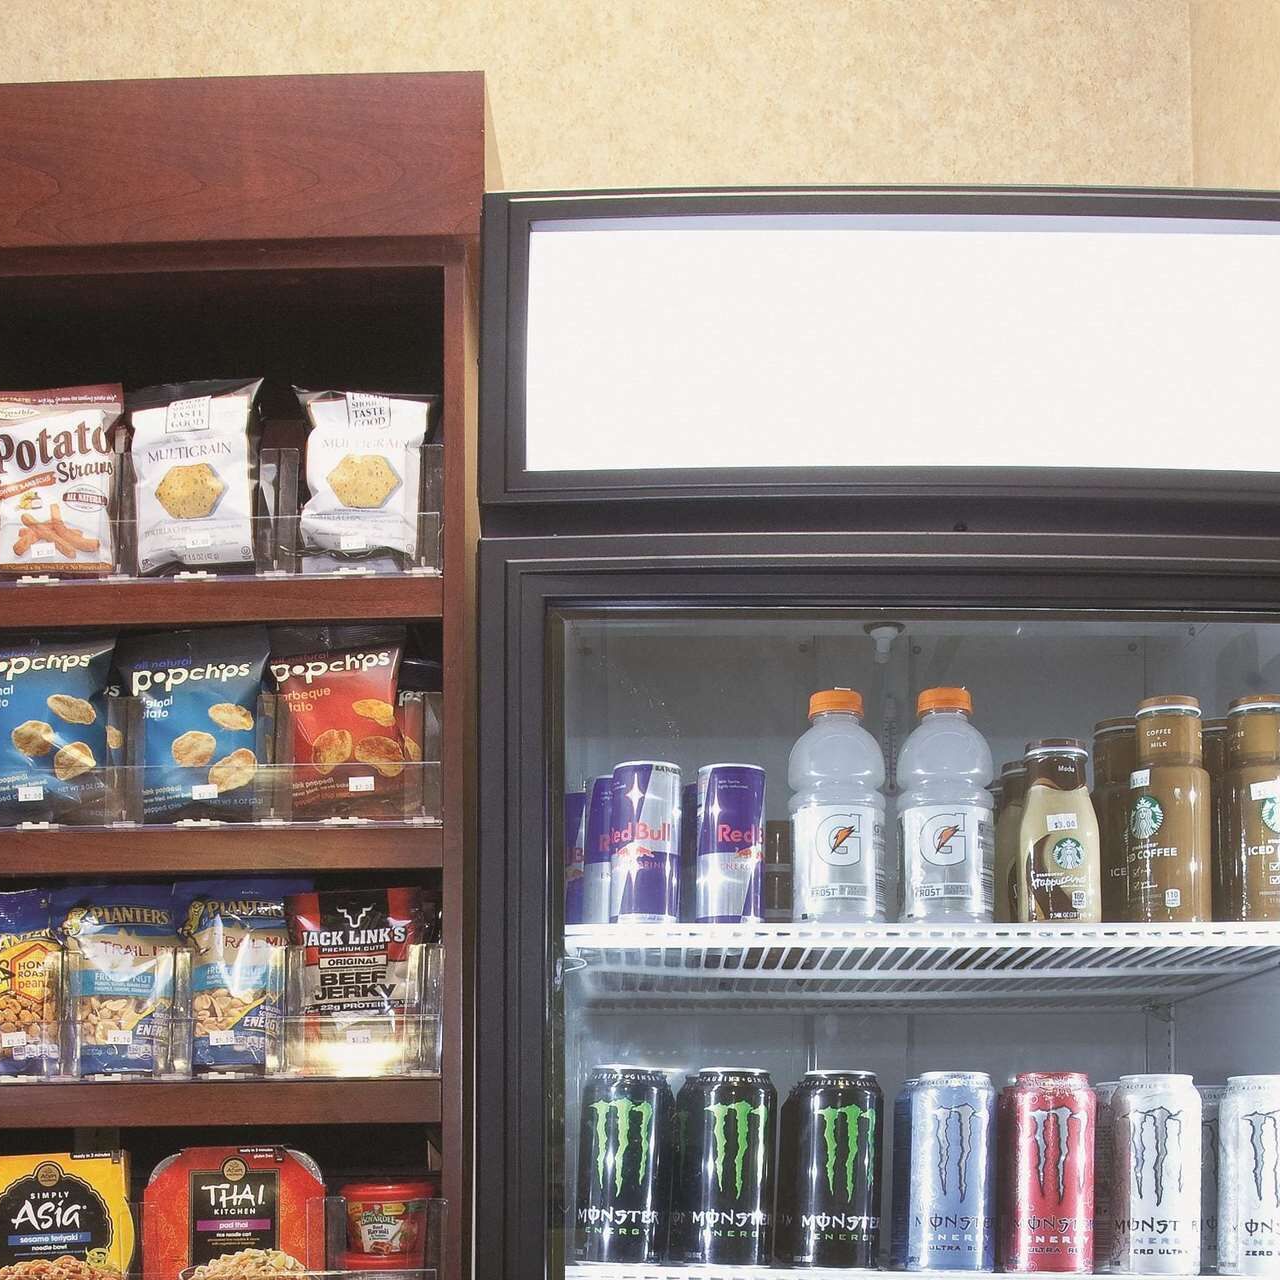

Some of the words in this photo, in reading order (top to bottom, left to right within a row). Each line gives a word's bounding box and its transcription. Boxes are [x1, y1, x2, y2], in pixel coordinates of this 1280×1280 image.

[351, 406, 388, 418] TASTE
[147, 441, 233, 462] MULTIGRAIN
[56, 461, 114, 483] Straws
[270, 651, 391, 689] popchips
[131, 661, 251, 696] popchips
[1146, 728, 1172, 737] COFFEE
[1137, 847, 1177, 859] COFFEE
[1248, 846, 1273, 856] ICED
[90, 906, 170, 926] PLANTERS
[302, 930, 350, 947] JACK
[354, 927, 406, 945] LINK'S
[321, 945, 363, 953] PREMIUM
[367, 944, 386, 952] CUTS
[328, 957, 377, 967] ORIGINAL
[320, 971, 386, 986] BEEF
[314, 983, 396, 1001] JERKY
[29, 1191, 69, 1200] SIMPLY
[200, 1183, 264, 1206] THAI
[11, 1200, 81, 1231] Asia
[214, 1207, 255, 1215] KITCHEN
[219, 1222, 233, 1230] pad
[235, 1221, 250, 1229] thai
[585, 1227, 650, 1235] ENERGY
